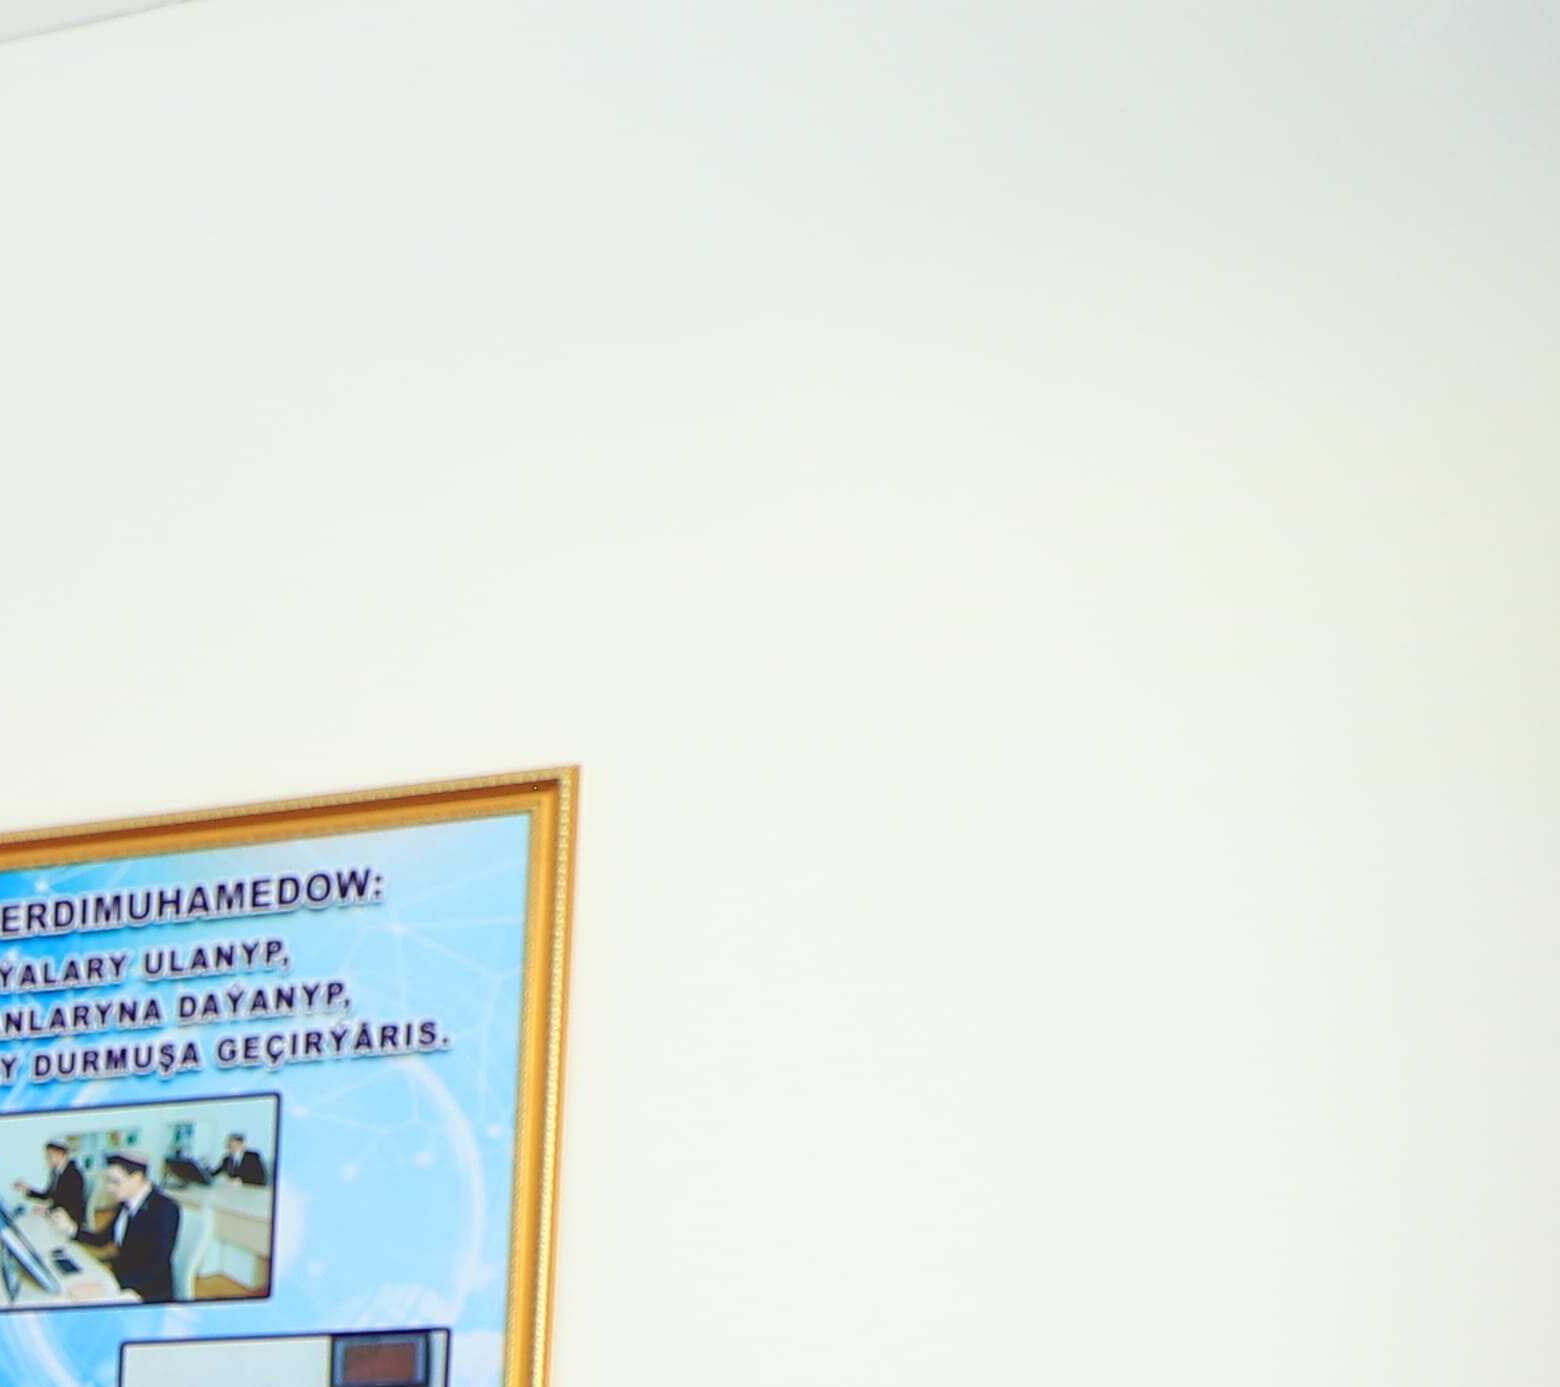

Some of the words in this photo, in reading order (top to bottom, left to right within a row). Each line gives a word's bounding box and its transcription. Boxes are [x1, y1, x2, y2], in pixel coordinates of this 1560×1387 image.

[144, 940, 290, 975] ULANYP,
[178, 981, 351, 1019] DAÝANYP,
[34, 1041, 201, 1077] DURMUŞA
